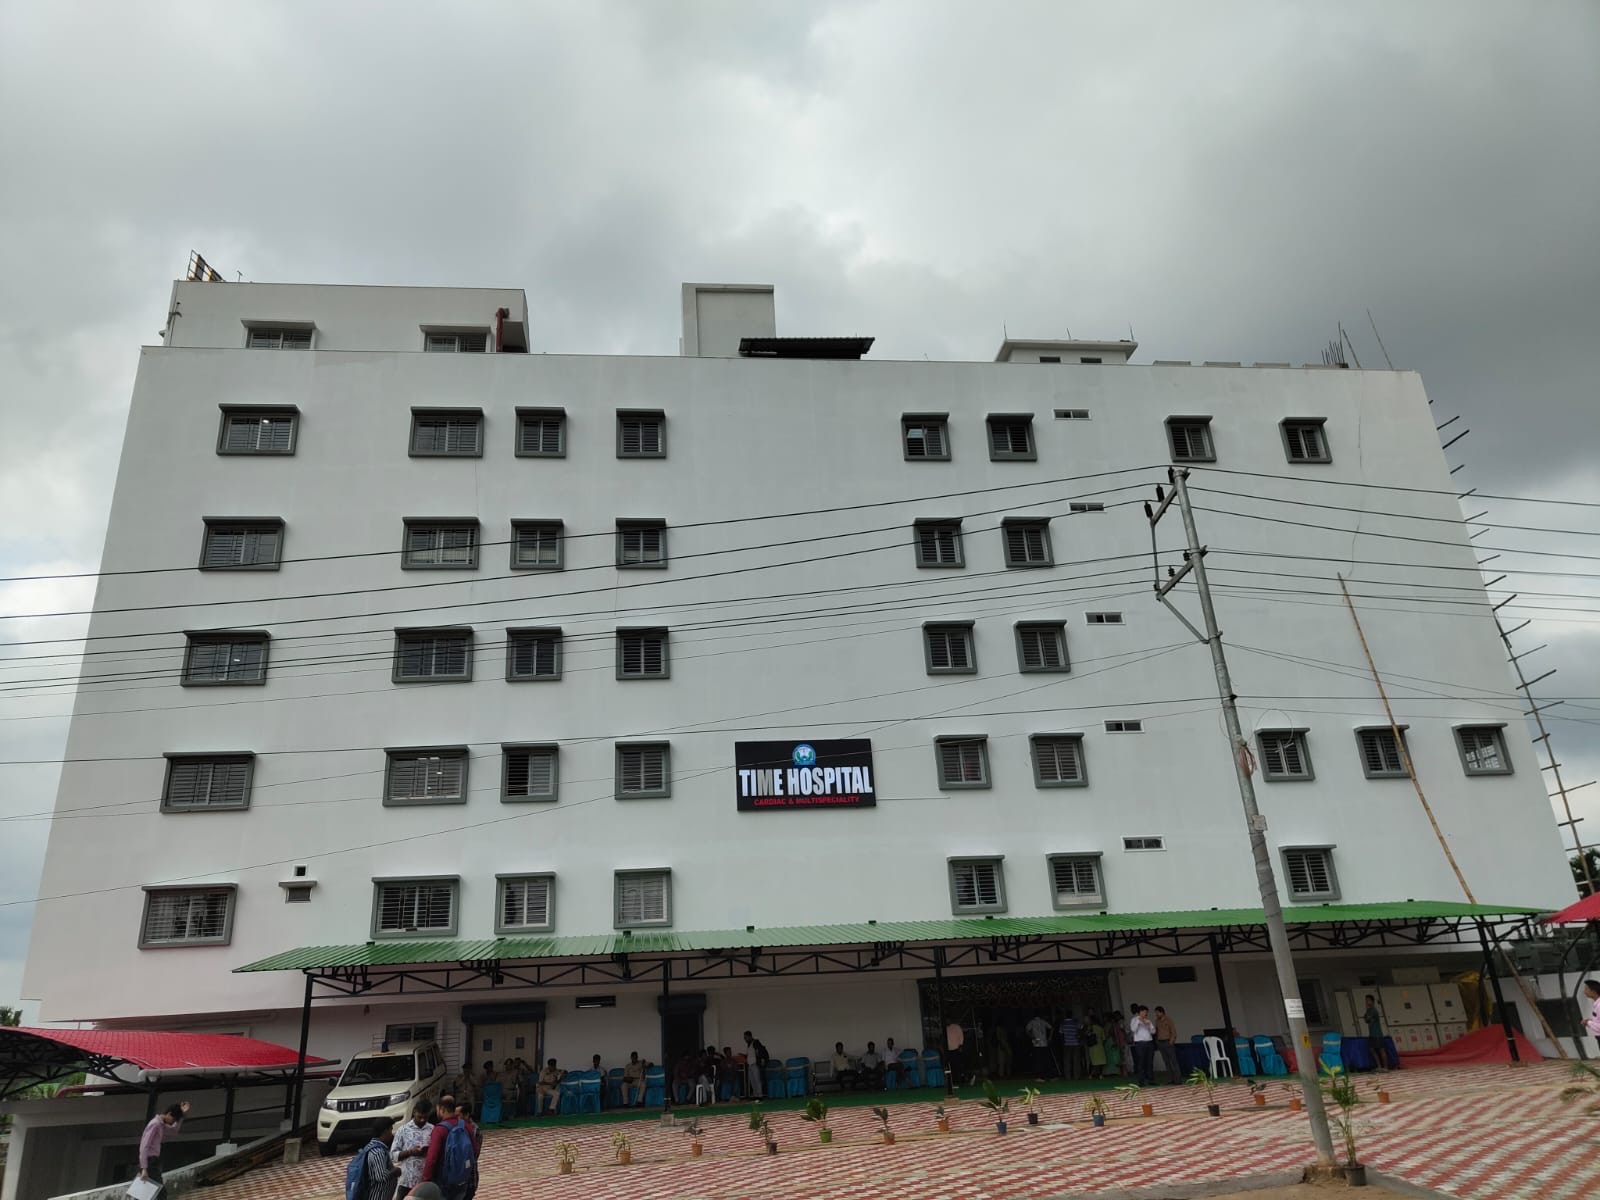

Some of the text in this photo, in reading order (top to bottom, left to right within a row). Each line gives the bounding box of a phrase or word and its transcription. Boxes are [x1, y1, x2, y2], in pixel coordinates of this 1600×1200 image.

[739, 766, 873, 796] TIME HOSPITAL
[754, 798, 786, 806] CARDIAC
